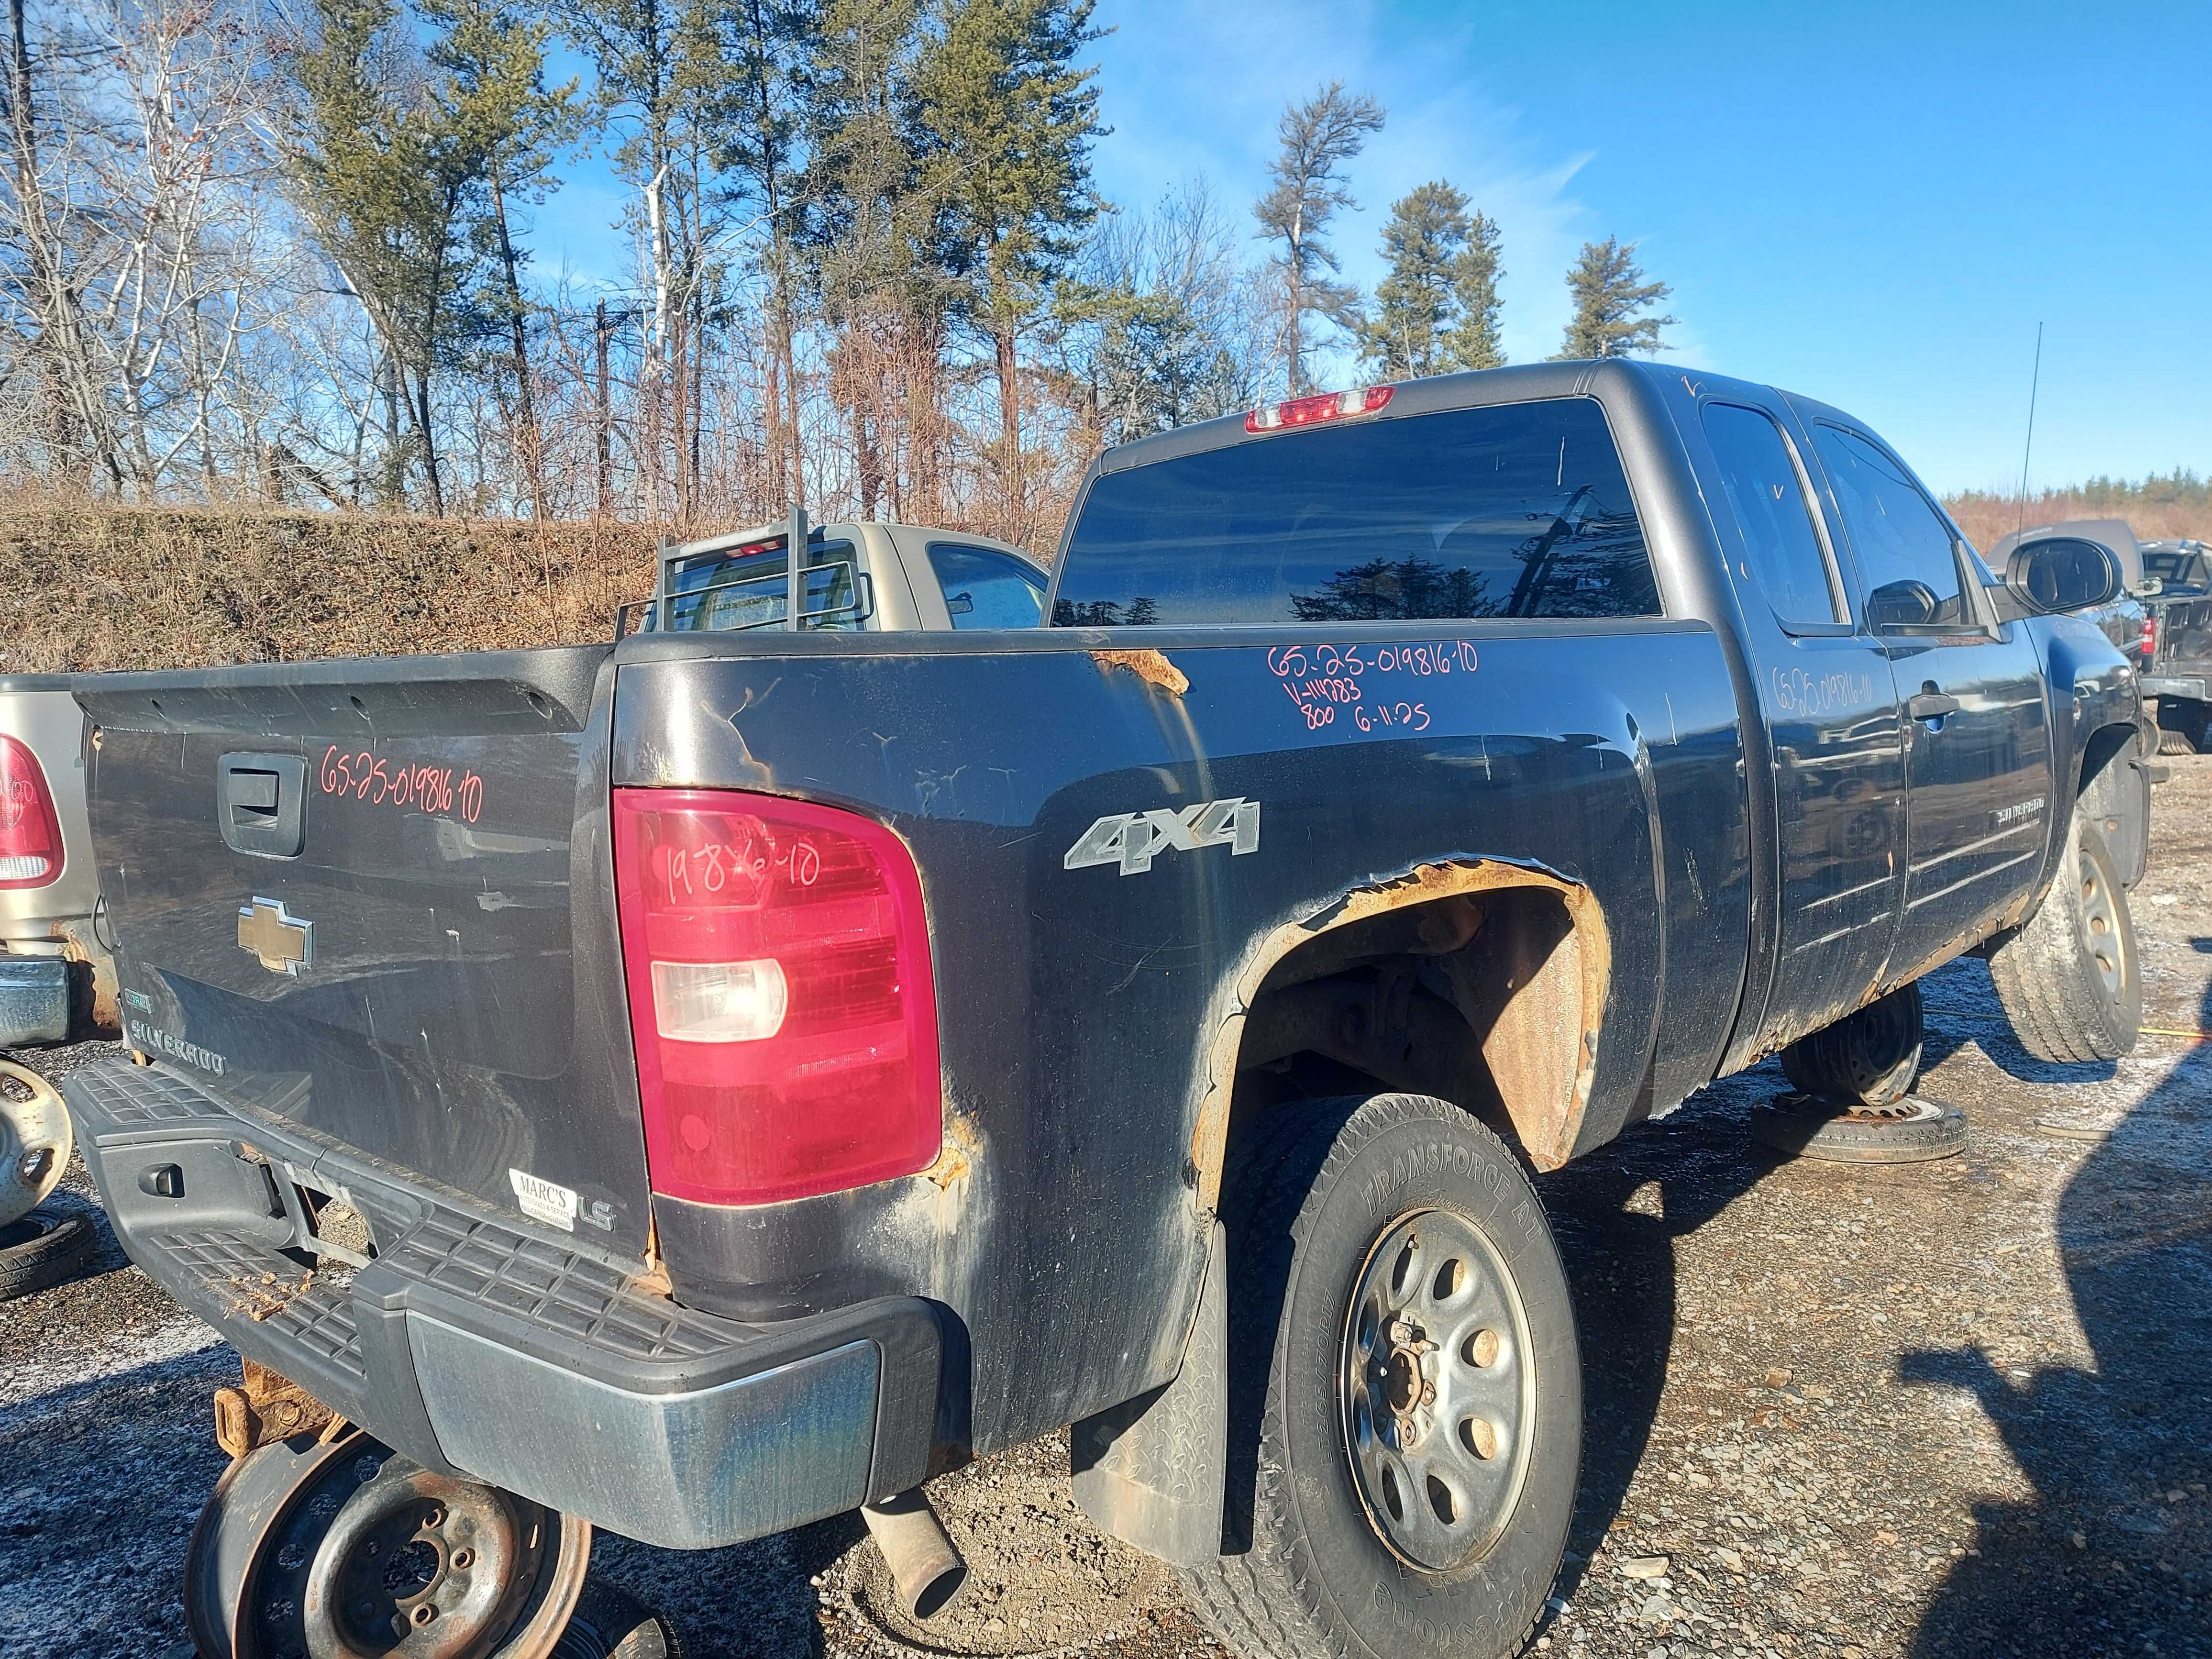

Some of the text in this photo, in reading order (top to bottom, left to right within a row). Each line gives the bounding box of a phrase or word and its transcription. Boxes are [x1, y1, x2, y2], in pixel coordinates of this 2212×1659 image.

[131, 1019, 226, 1076] SILVERADO
[520, 1174, 566, 1208] MARC'S
[577, 1195, 615, 1232] LS
[1360, 1142, 1511, 1216] TRANSFORCE
[1511, 1200, 1545, 1242] AT
